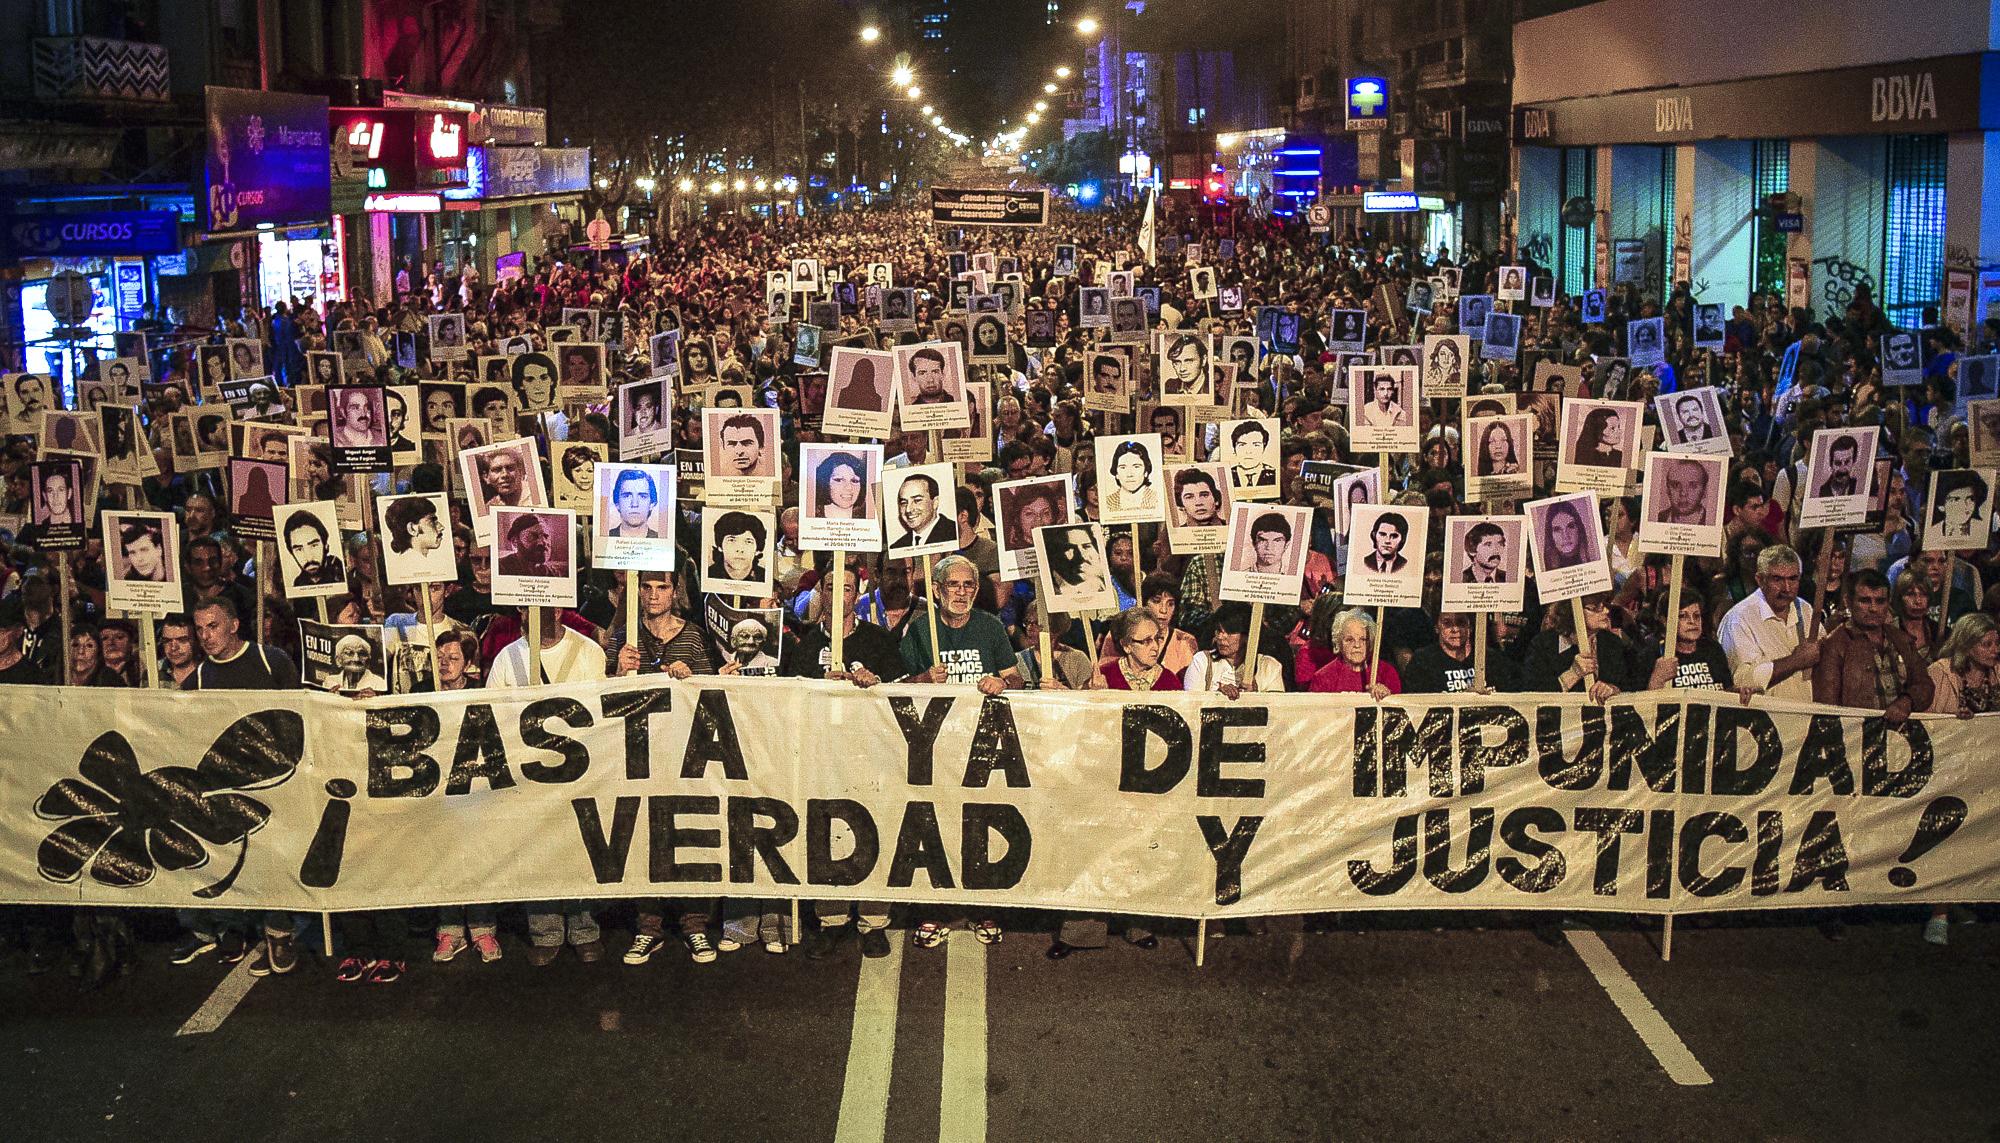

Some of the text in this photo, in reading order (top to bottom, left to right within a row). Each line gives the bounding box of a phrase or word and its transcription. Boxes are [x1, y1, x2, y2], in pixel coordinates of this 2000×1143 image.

[1872, 73, 1937, 121] BBVA
[1655, 97, 1693, 132] BBVA
[1468, 120, 1503, 133] BBVA
[1524, 111, 1550, 138] BBVA
[237, 191, 263, 206] CURSOS
[62, 222, 133, 241] CURSOS
[236, 388, 248, 397] TU
[680, 461, 693, 472] EN
[1305, 472, 1331, 485] EN TU
[708, 605, 729, 632] EN TU
[306, 635, 331, 654] EN TU
[940, 650, 980, 662] TODOS
[946, 662, 983, 673] OMOS
[1445, 668, 1475, 680] TODO
[1675, 673, 1713, 687] SOMOS
[888, 695, 1031, 788] YA
[1118, 704, 1268, 798] DE
[1353, 705, 1934, 799] IMPUNIDAD
[571, 795, 1031, 890] VERDAD
[1197, 815, 1264, 905] Y
